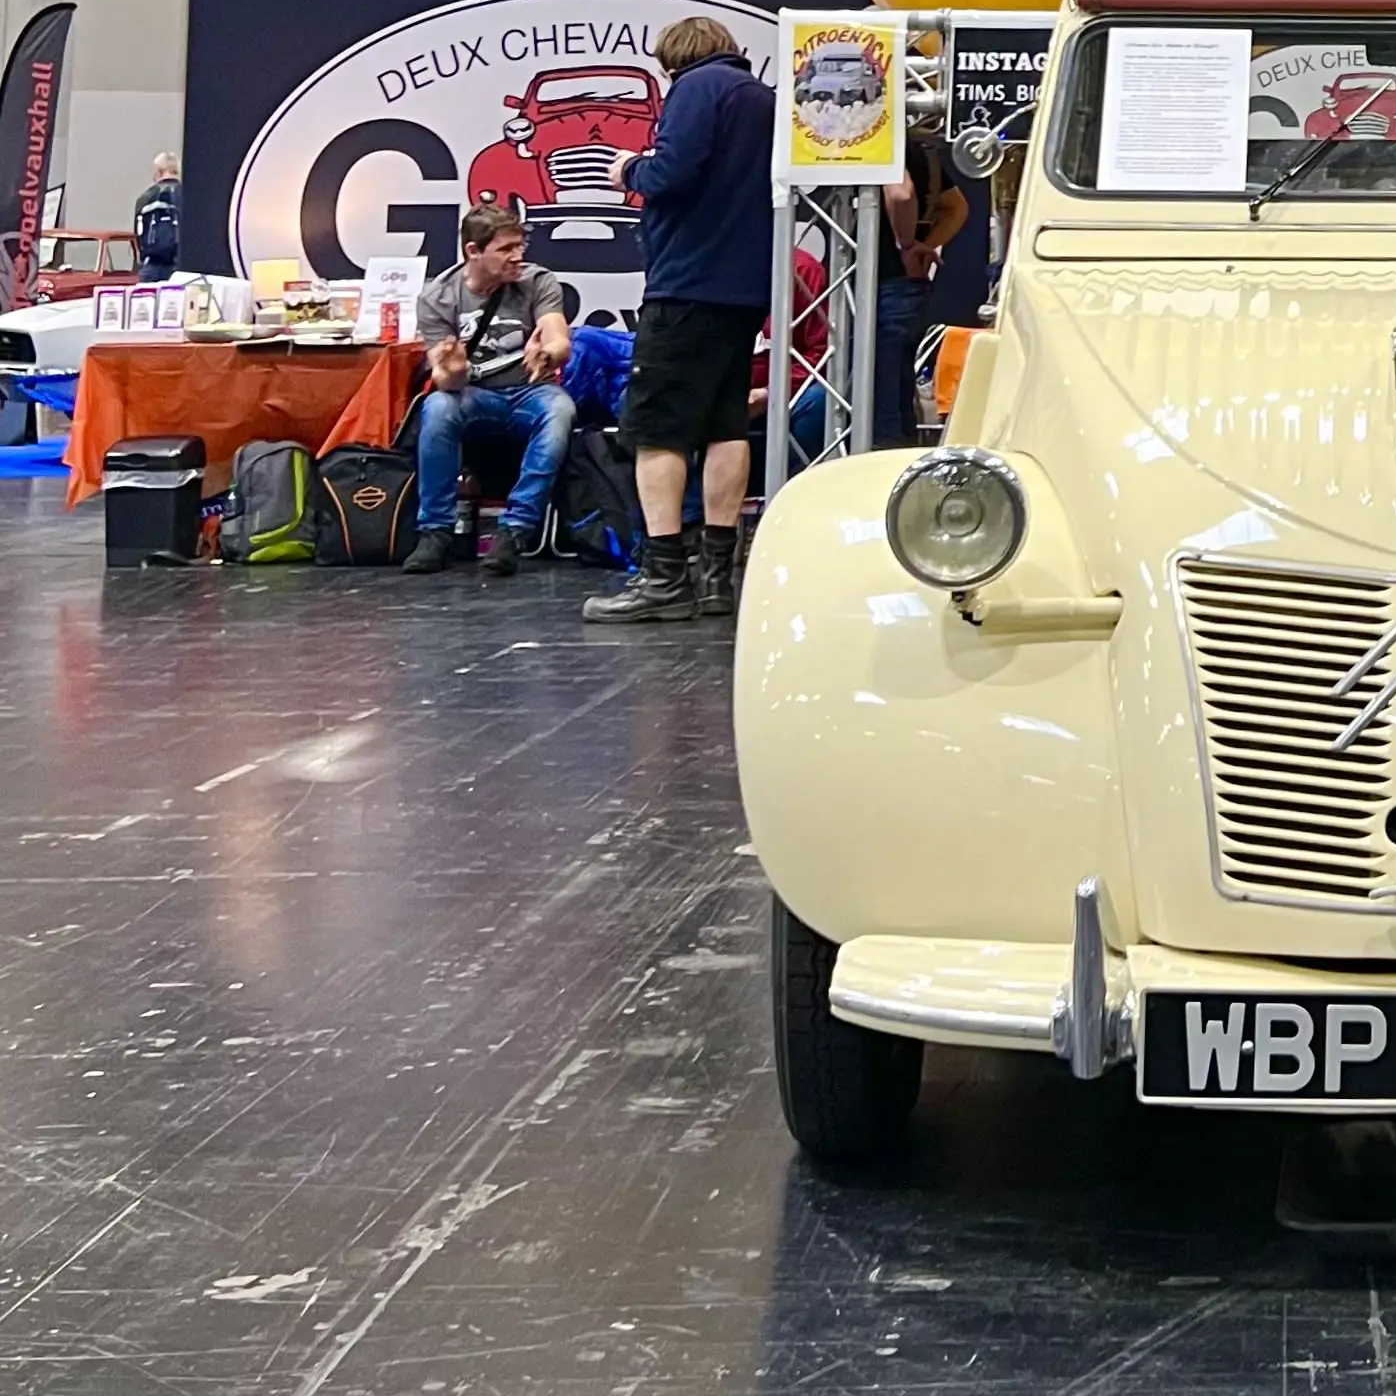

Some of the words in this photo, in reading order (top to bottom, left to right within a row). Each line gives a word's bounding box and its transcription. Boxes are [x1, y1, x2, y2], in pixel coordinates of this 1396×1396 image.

[377, 36, 490, 103] DEUX
[1257, 55, 1316, 88] DEUX
[1185, 1001, 1388, 1093] WBP
